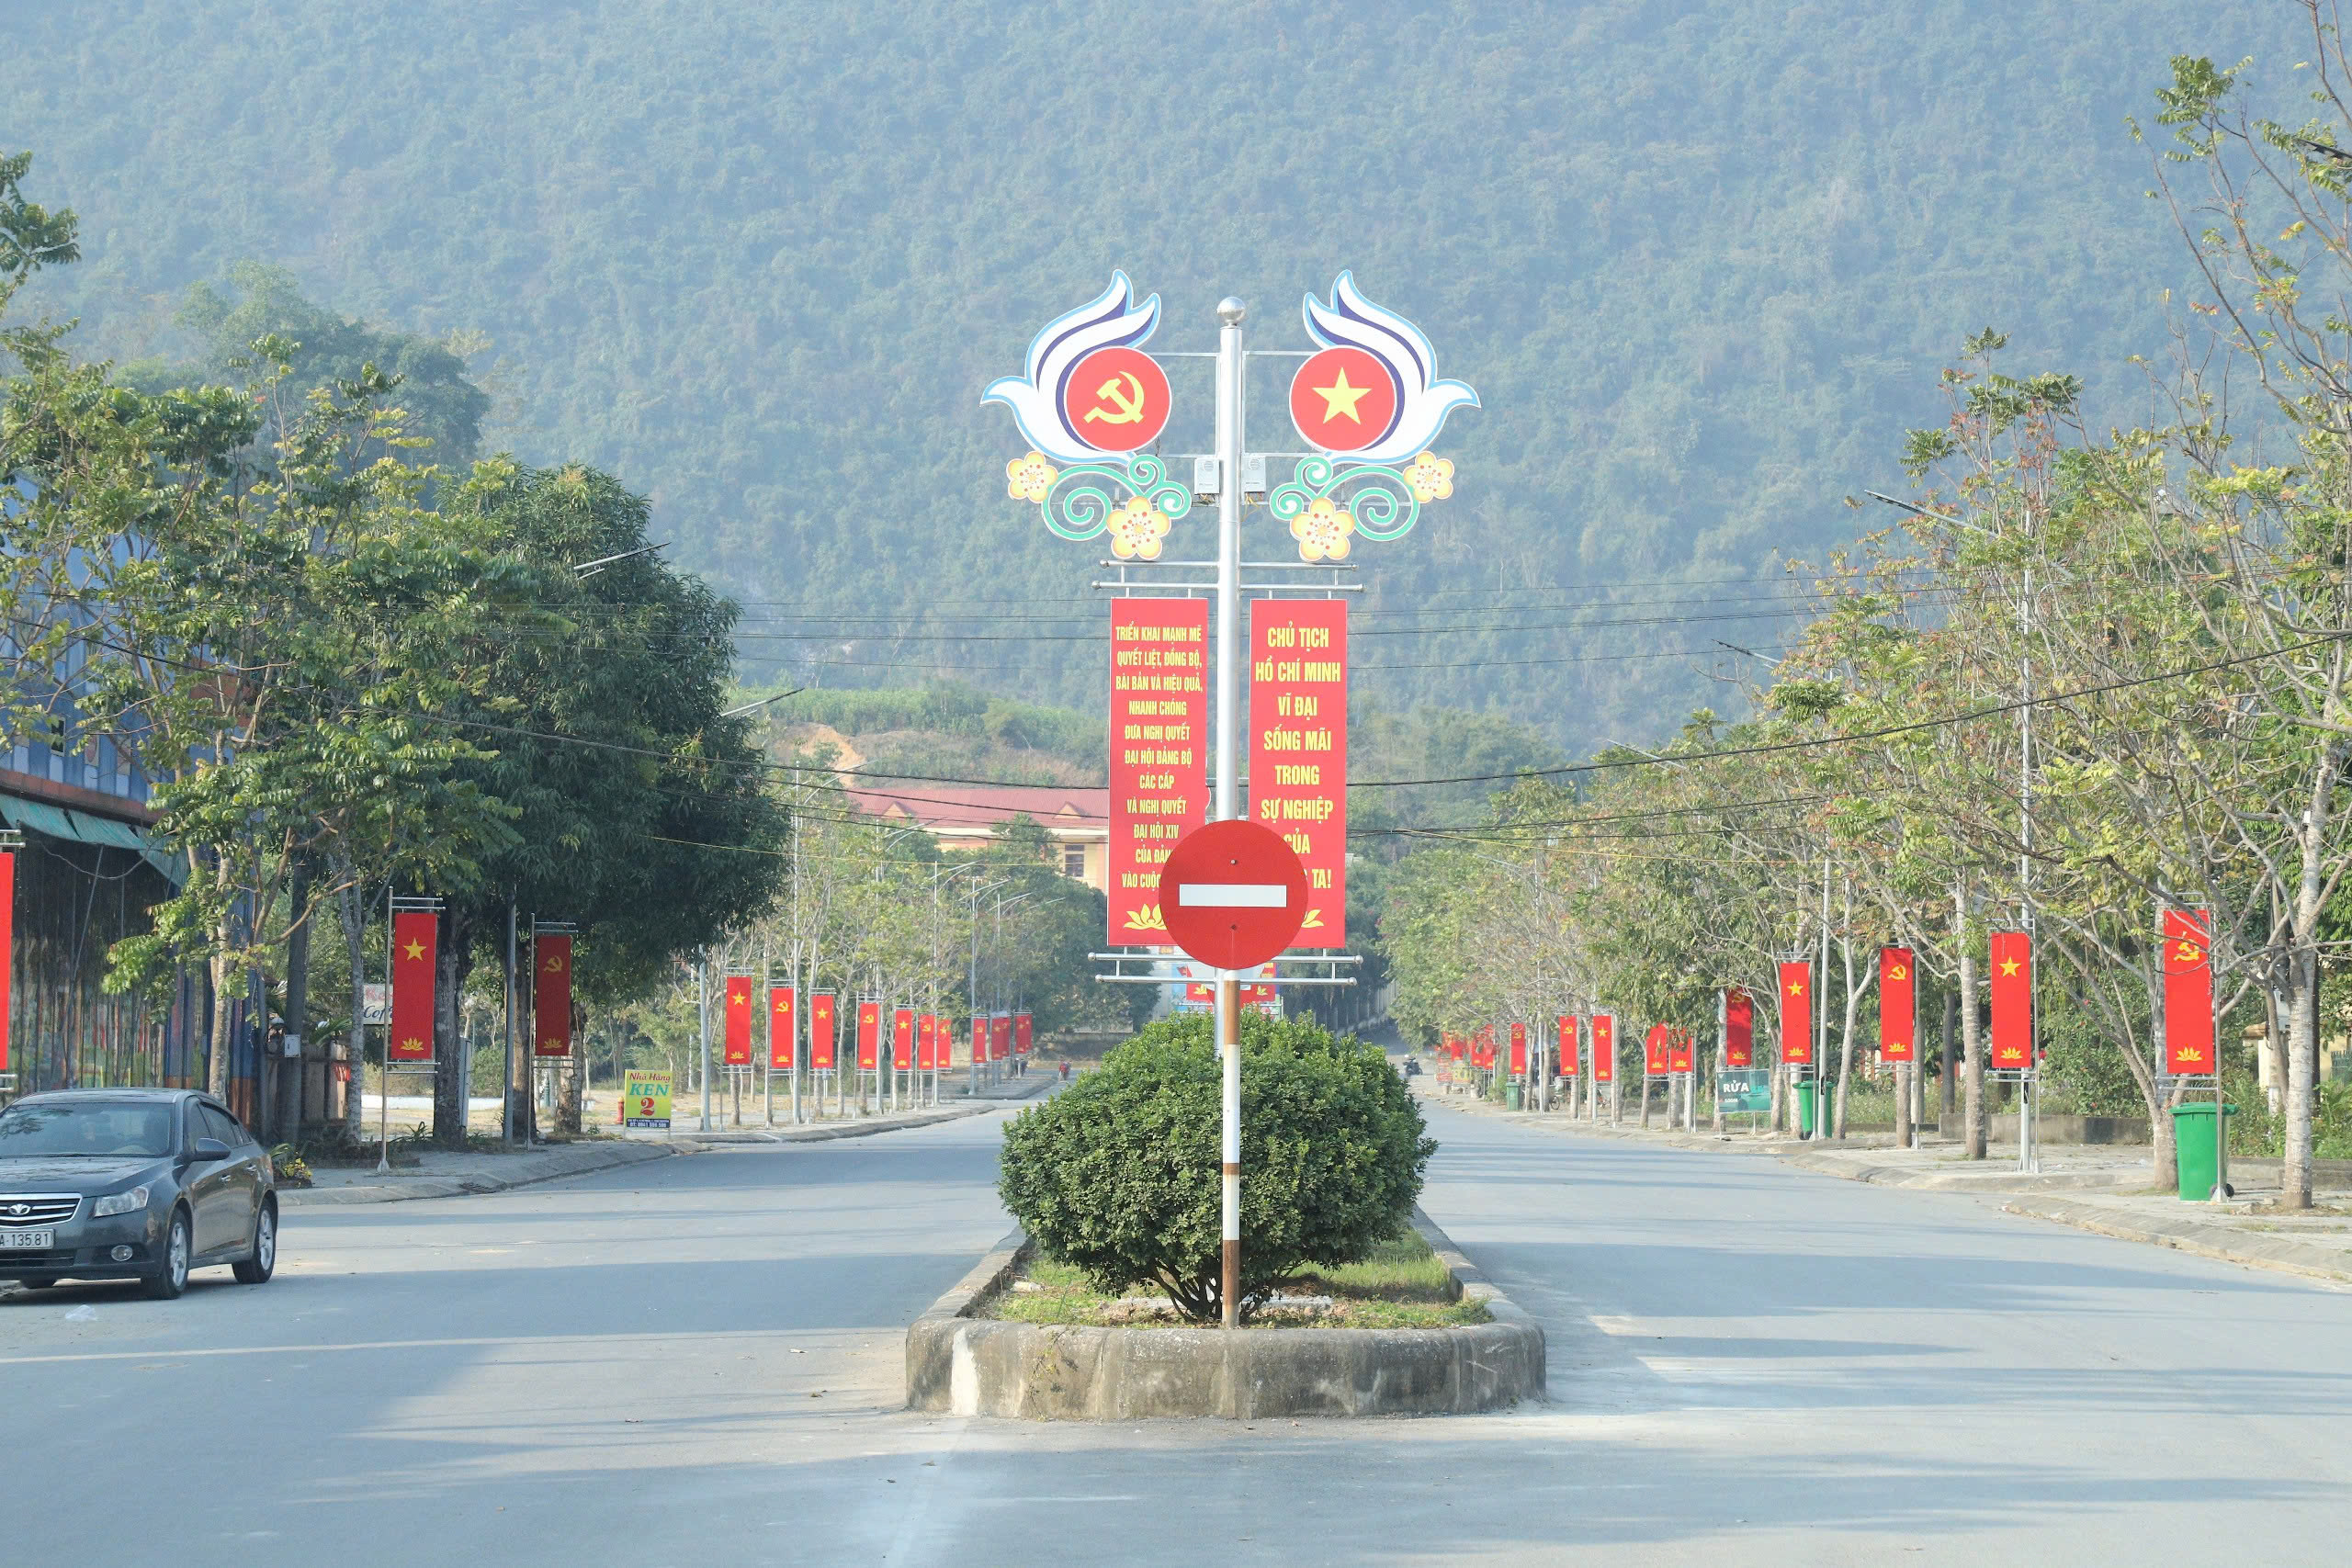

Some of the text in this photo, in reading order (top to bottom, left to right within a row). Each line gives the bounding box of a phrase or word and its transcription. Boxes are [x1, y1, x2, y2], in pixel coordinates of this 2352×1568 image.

[1115, 621, 1139, 640] TRIỂN
[1141, 626, 1160, 641] KHAI
[1162, 627, 1187, 644] MẠNH
[1268, 621, 1329, 651] CHỦ TỊCH
[1117, 647, 1142, 667] QUYẾT
[1145, 649, 1161, 669] LIỆT,
[1188, 649, 1202, 670] BỘ,
[1256, 655, 1340, 682] HỒ CHÍ MINH
[1132, 671, 1148, 690] BẢN
[1151, 673, 1161, 691] VÀ
[1163, 673, 1182, 694] HIỆU
[1184, 672, 1203, 693] QUẢ,
[1129, 698, 1187, 716] NHANH CHÓNG
[1278, 693, 1317, 720] VĨ ĐẠI
[1125, 721, 1190, 742] ĐƯA NGHỊ QUYẾT
[1264, 724, 1331, 750] SỐNG MÃI
[1125, 746, 1192, 768] ĐẠI HỘI ĐẢNG BỘ
[1139, 770, 1174, 789] CÁC CẤP
[1275, 765, 1319, 784] TRONG
[1127, 795, 1186, 817] VÀ NGHỊ QUYẾT
[1261, 795, 1333, 824] SỰ NGHIỆP
[1134, 821, 1179, 841] ĐẠI HỘI XIV
[1136, 844, 1152, 863] CỦA
[1122, 871, 1137, 887] VÀO
[1312, 869, 1331, 888] TA!
[629, 1072, 671, 1083] Nhà Hàng
[1724, 1080, 1749, 1093] RỬA
[629, 1083, 670, 1096] KEN
[640, 1097, 655, 1116] 2
